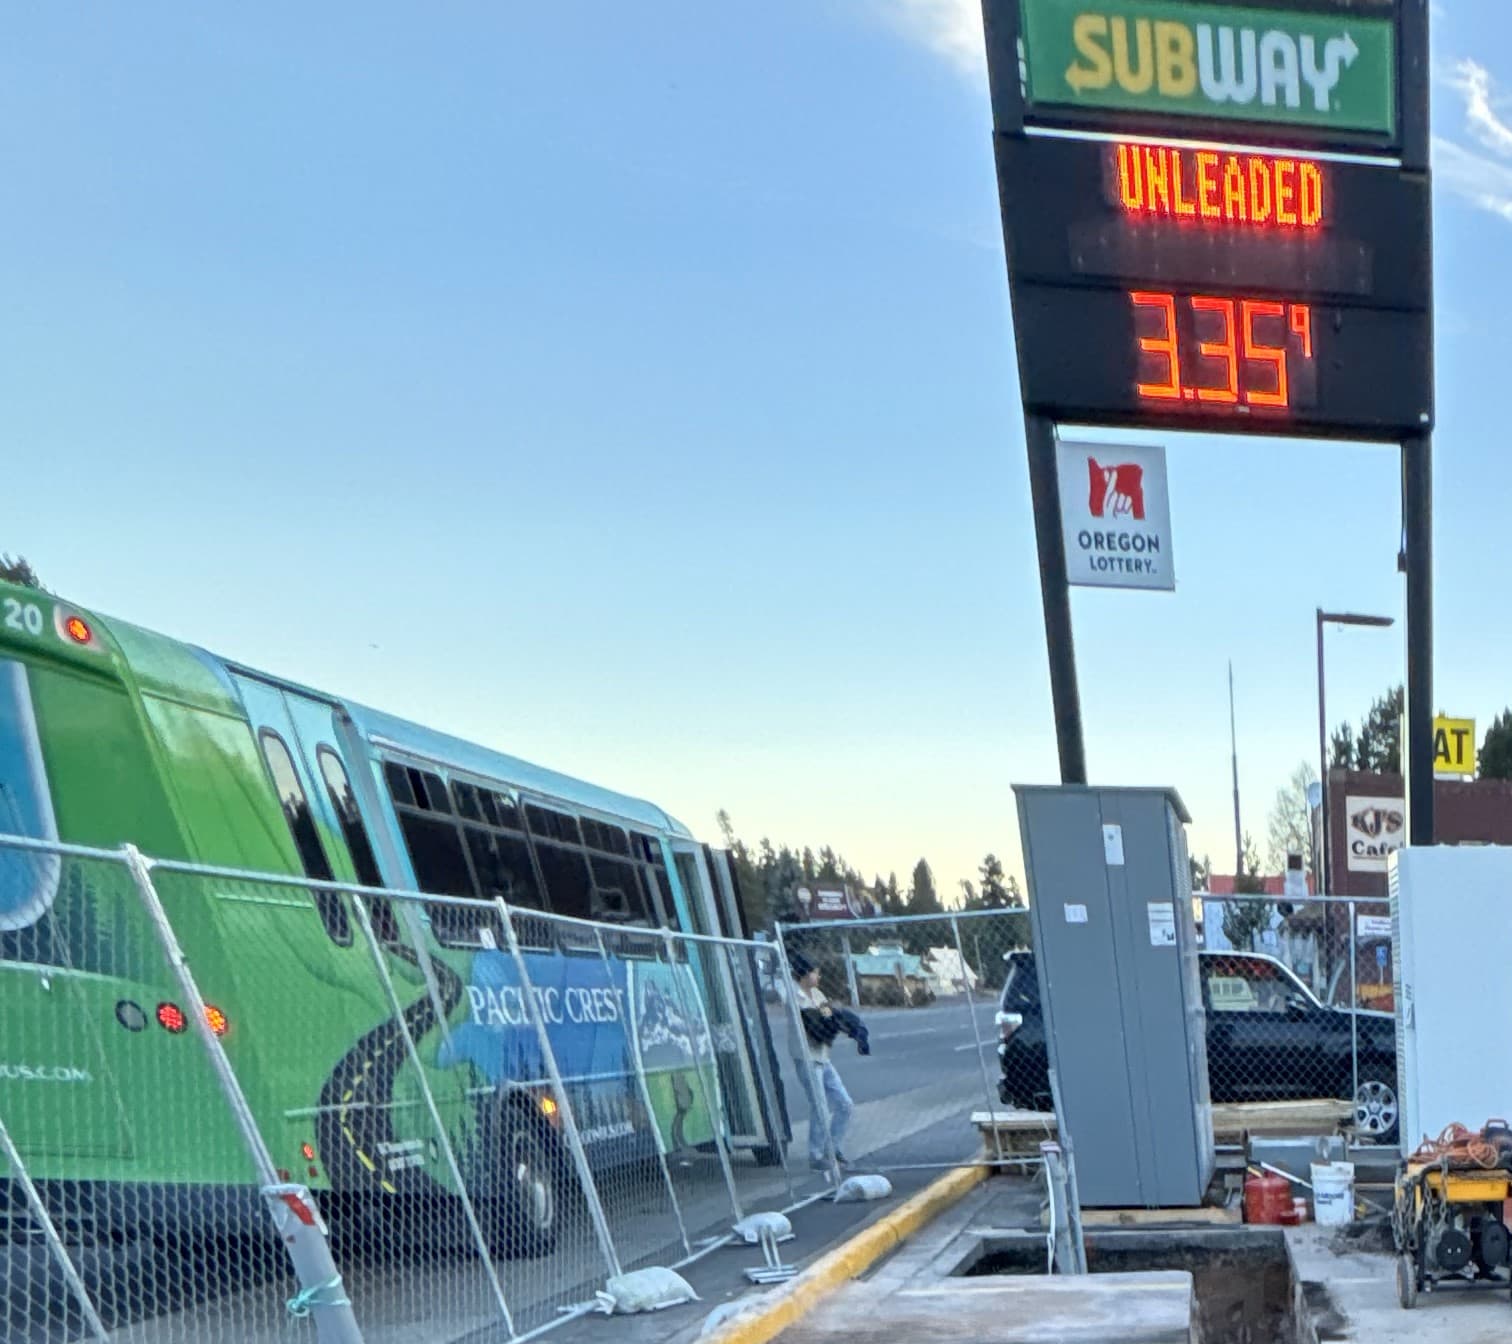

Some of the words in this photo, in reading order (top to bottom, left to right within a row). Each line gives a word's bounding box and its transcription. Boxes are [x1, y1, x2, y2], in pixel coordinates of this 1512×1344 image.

[1065, 14, 1359, 112] SUBWAY
[1117, 143, 1323, 227] UNLEADED
[1078, 529, 1160, 553] OREGON
[1089, 555, 1153, 575] LOTTERY
[3, 597, 43, 636] 20
[1433, 727, 1469, 764] AT
